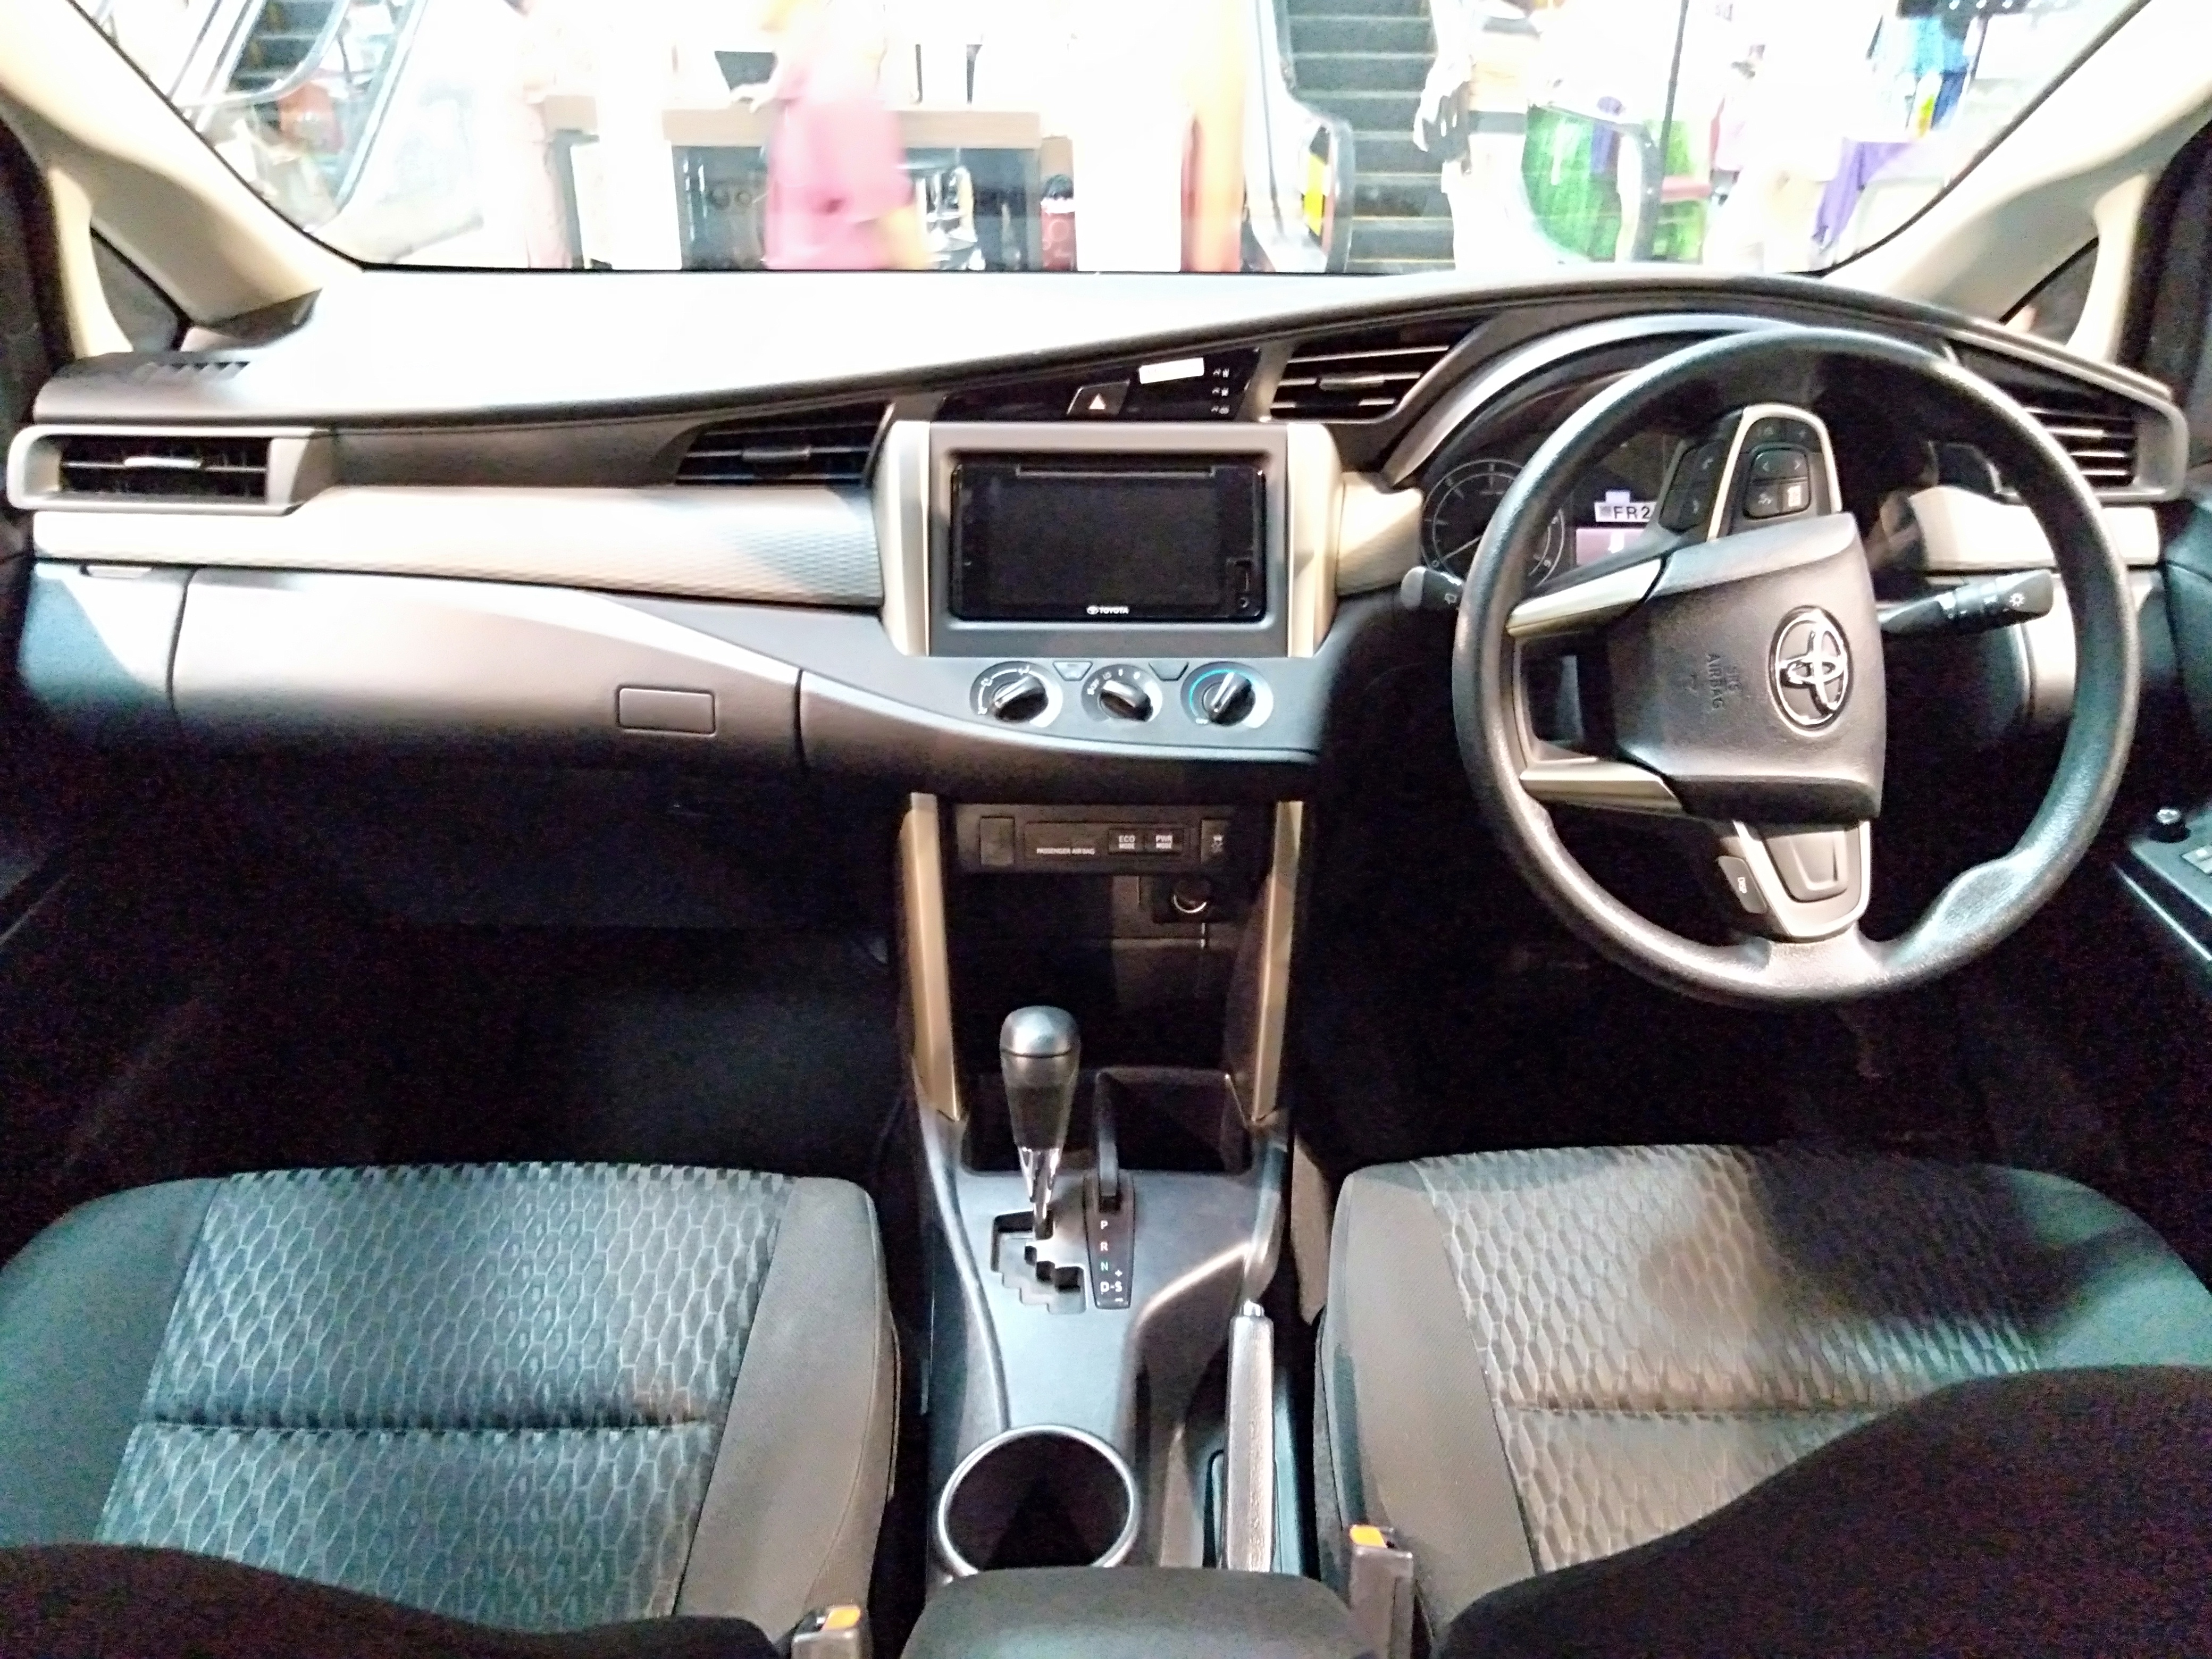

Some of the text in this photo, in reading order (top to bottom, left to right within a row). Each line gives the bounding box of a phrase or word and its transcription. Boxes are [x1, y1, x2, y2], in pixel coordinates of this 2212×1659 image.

[1706, 653, 1724, 709] AIRBAG
[1100, 1220, 1108, 1229] P
[1100, 1241, 1108, 1251] R
[1100, 1261, 1109, 1271] N
